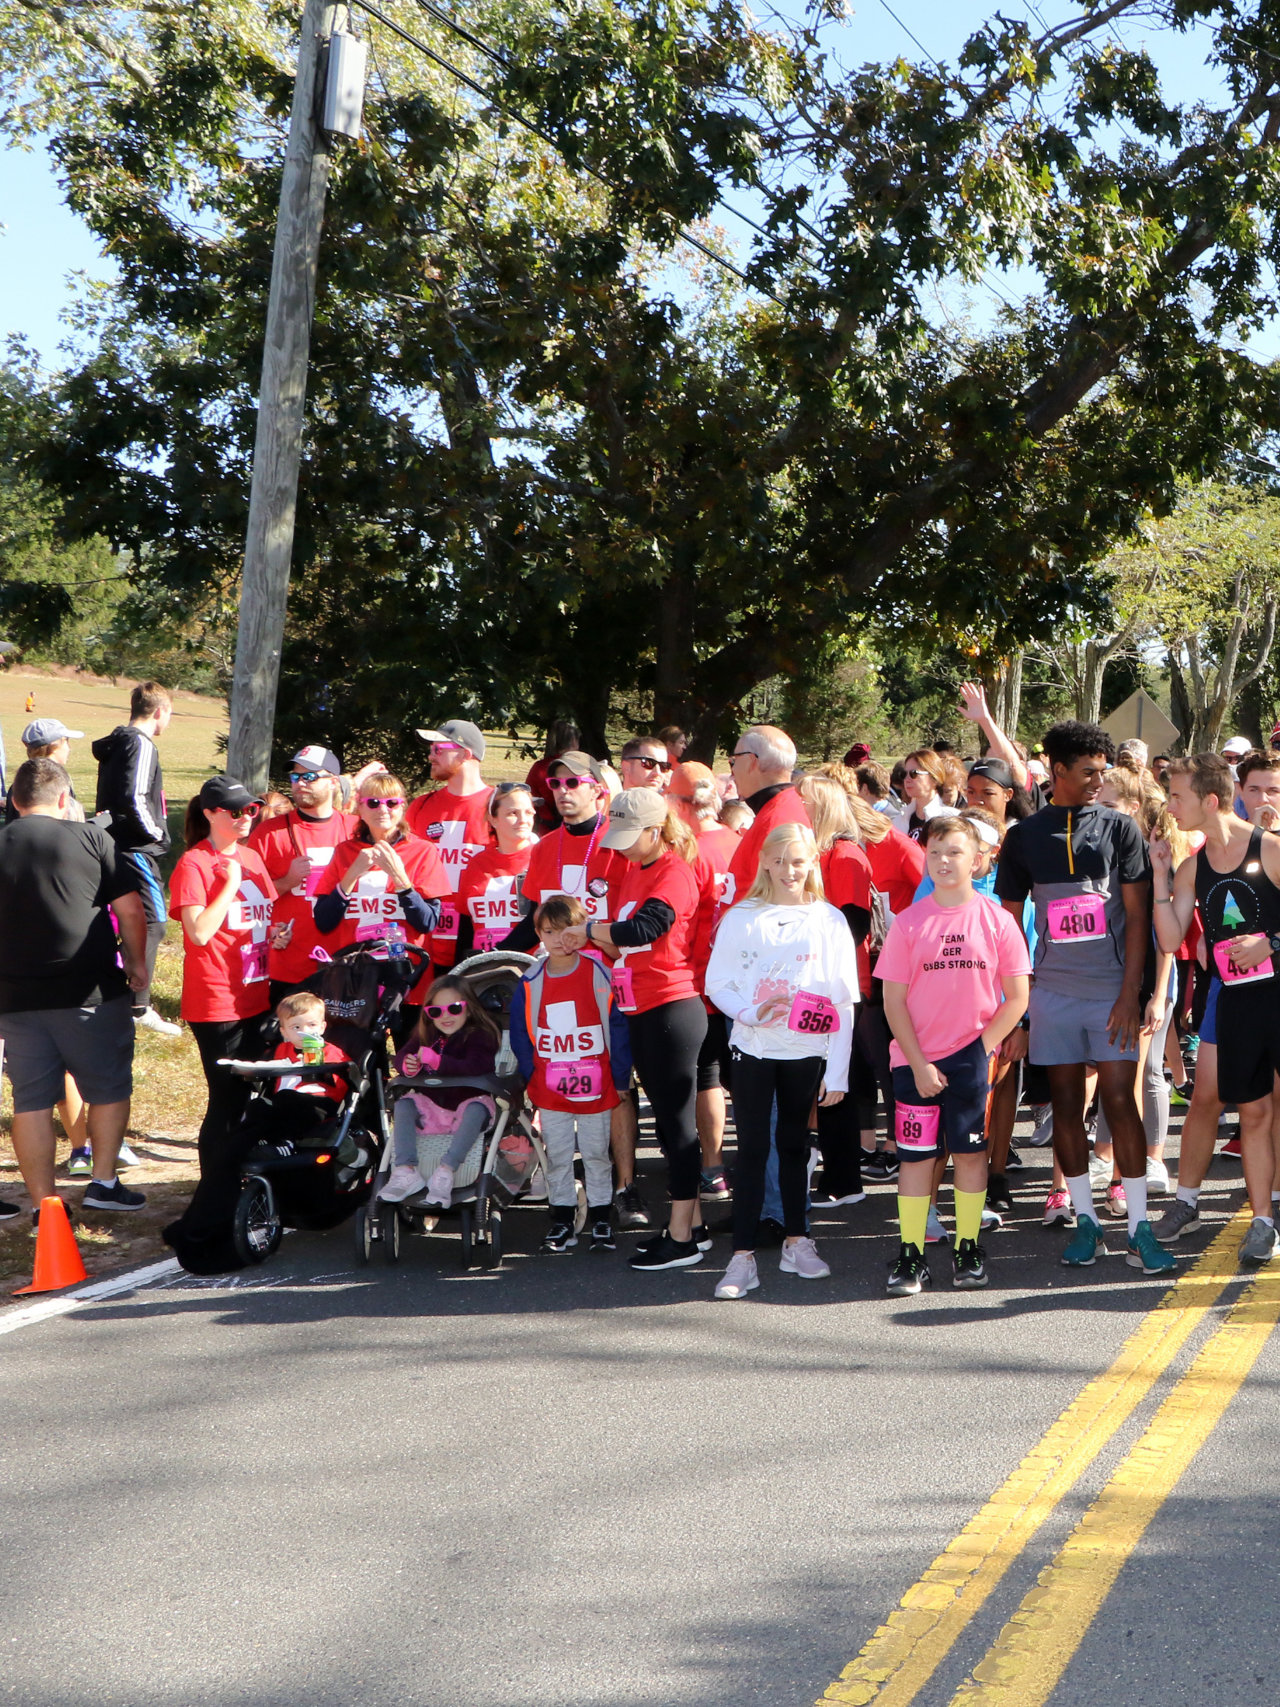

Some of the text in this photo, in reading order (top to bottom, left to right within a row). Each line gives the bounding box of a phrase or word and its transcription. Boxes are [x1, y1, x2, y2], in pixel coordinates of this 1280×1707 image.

[241, 903, 272, 922] EMS
[345, 898, 398, 916] EMS
[472, 900, 519, 918] EMS
[1060, 913, 1095, 935] 480
[940, 934, 965, 944] TEAM
[943, 947, 961, 956] GER
[948, 960, 986, 970] STRONG
[324, 999, 367, 1009] SAUNDERS
[798, 1010, 833, 1032] 356
[538, 1032, 594, 1053] EMS
[557, 1076, 592, 1094] 429
[903, 1121, 922, 1139] 89
